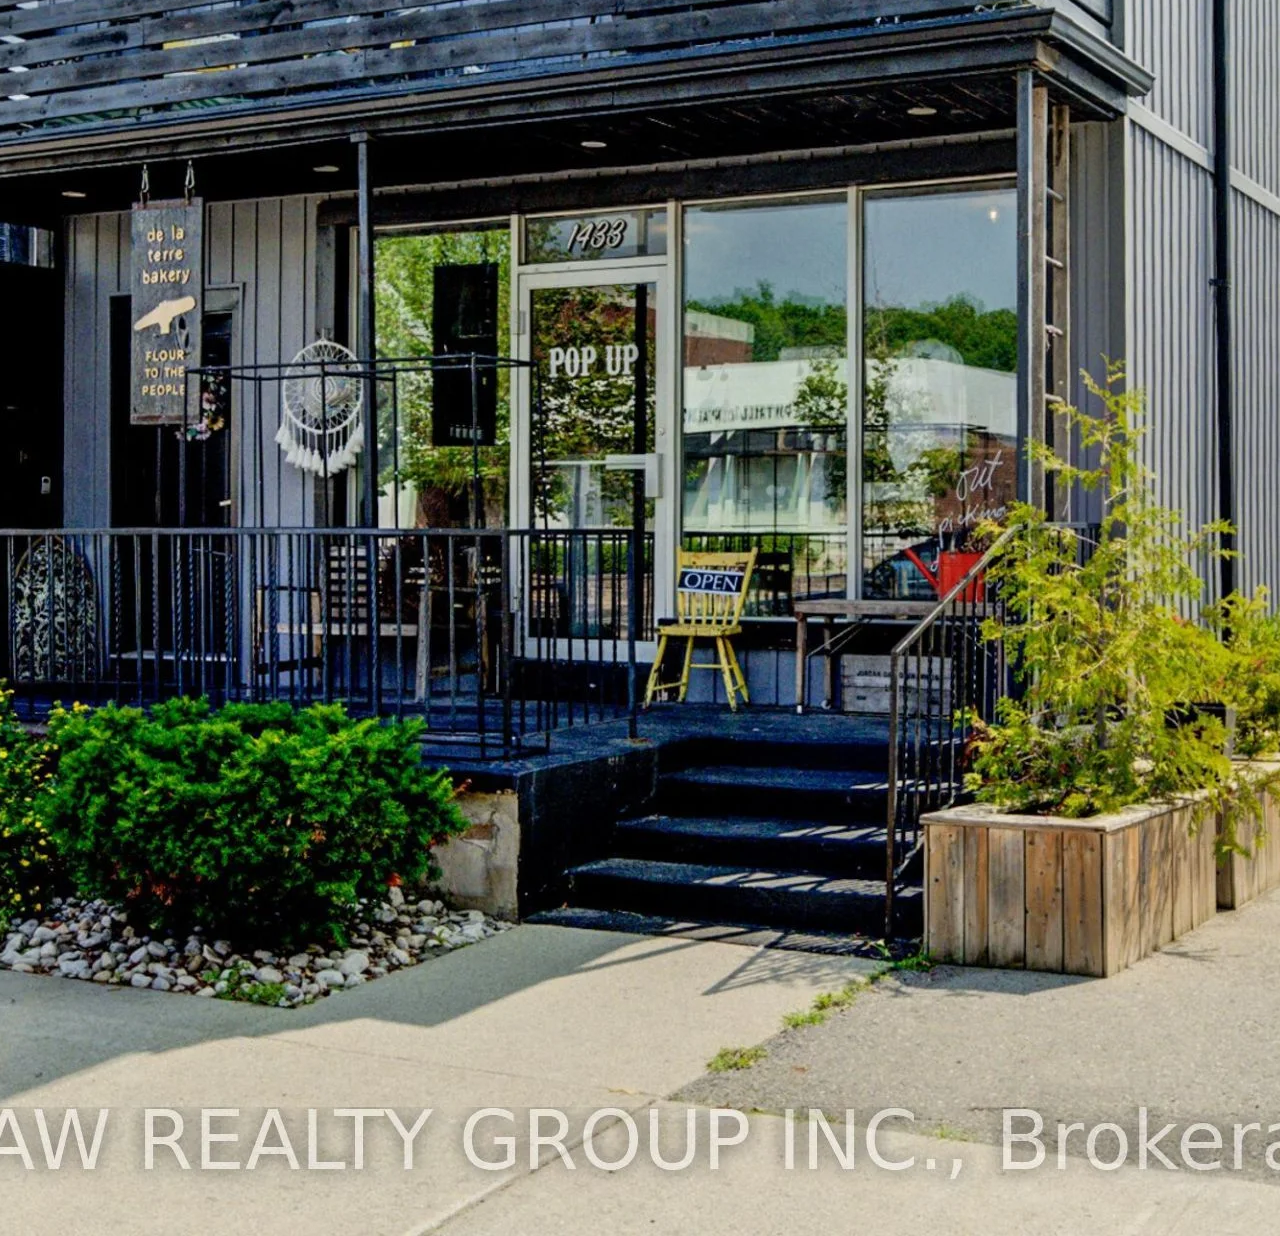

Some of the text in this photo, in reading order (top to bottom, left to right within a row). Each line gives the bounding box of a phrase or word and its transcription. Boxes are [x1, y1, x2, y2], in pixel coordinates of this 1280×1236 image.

[147, 224, 185, 242] de la
[567, 219, 627, 252] 1433
[148, 248, 185, 263] terre
[142, 268, 191, 285] bakery
[145, 349, 184, 362] FLOUR
[549, 343, 639, 378] POP UP
[144, 366, 184, 378] TO THE
[142, 384, 185, 396] PEOPLE
[684, 572, 739, 592] OPEN
